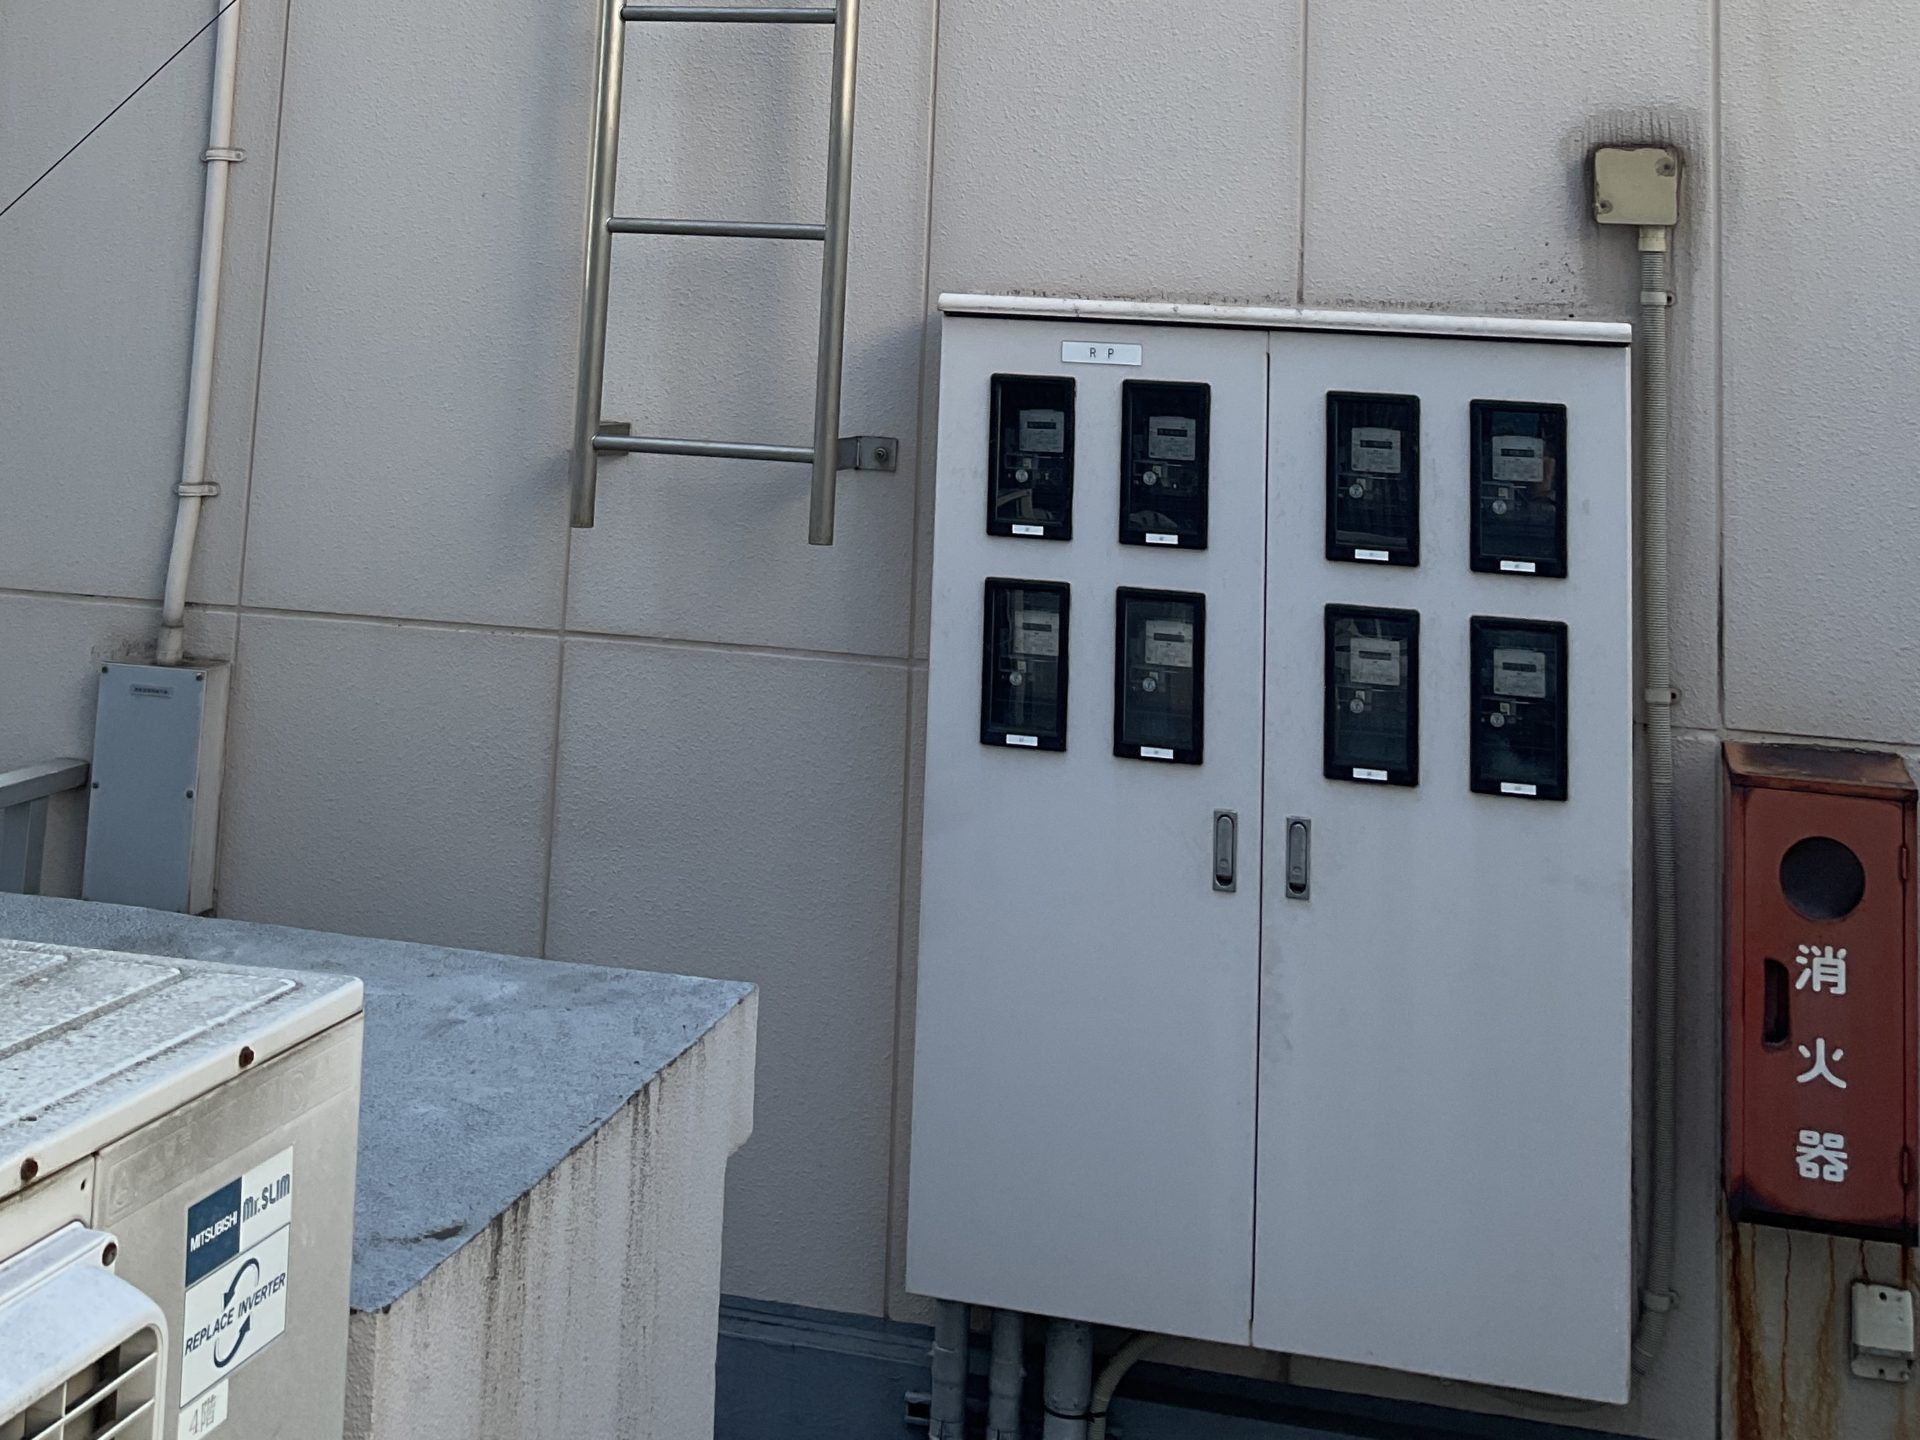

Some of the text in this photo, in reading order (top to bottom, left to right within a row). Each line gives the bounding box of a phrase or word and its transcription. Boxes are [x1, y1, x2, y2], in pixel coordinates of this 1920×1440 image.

[1795, 944, 1848, 1183] 消火器
[190, 1210, 239, 1252] MITSUBISHI
[185, 1272, 286, 1356] REPLACE INVERTER
